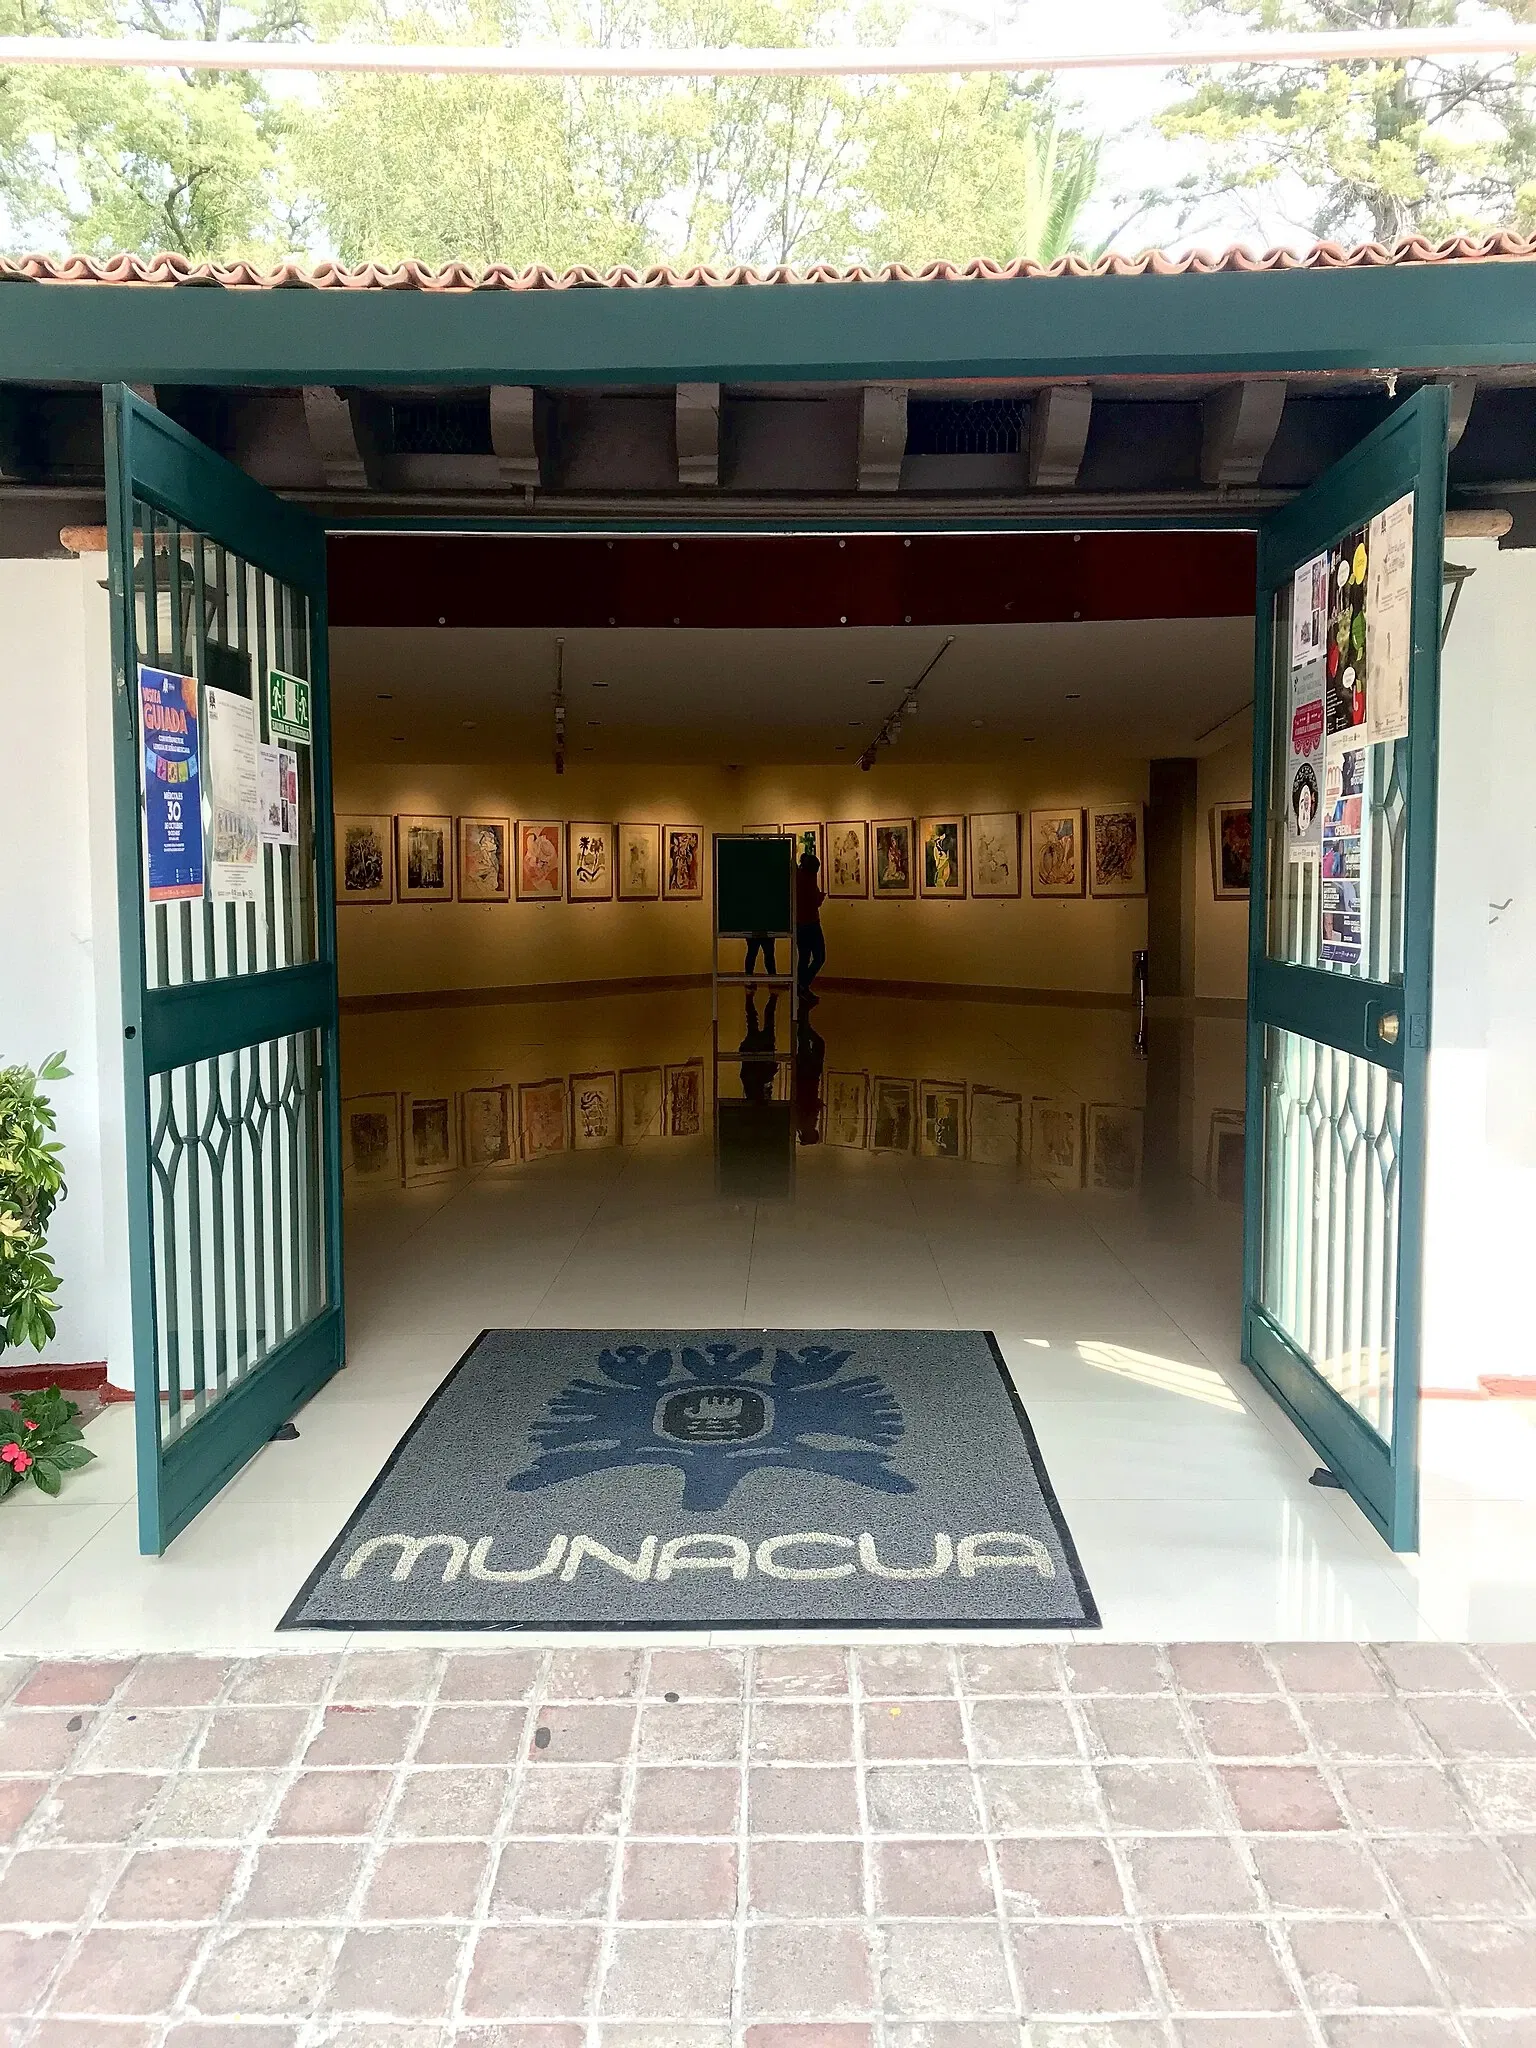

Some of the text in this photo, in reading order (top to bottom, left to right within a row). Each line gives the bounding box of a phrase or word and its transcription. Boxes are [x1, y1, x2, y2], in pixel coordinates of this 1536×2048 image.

[144, 704, 188, 734] GUIADA
[167, 801, 181, 821] 30
[342, 1531, 1056, 1584] MUNACUA
